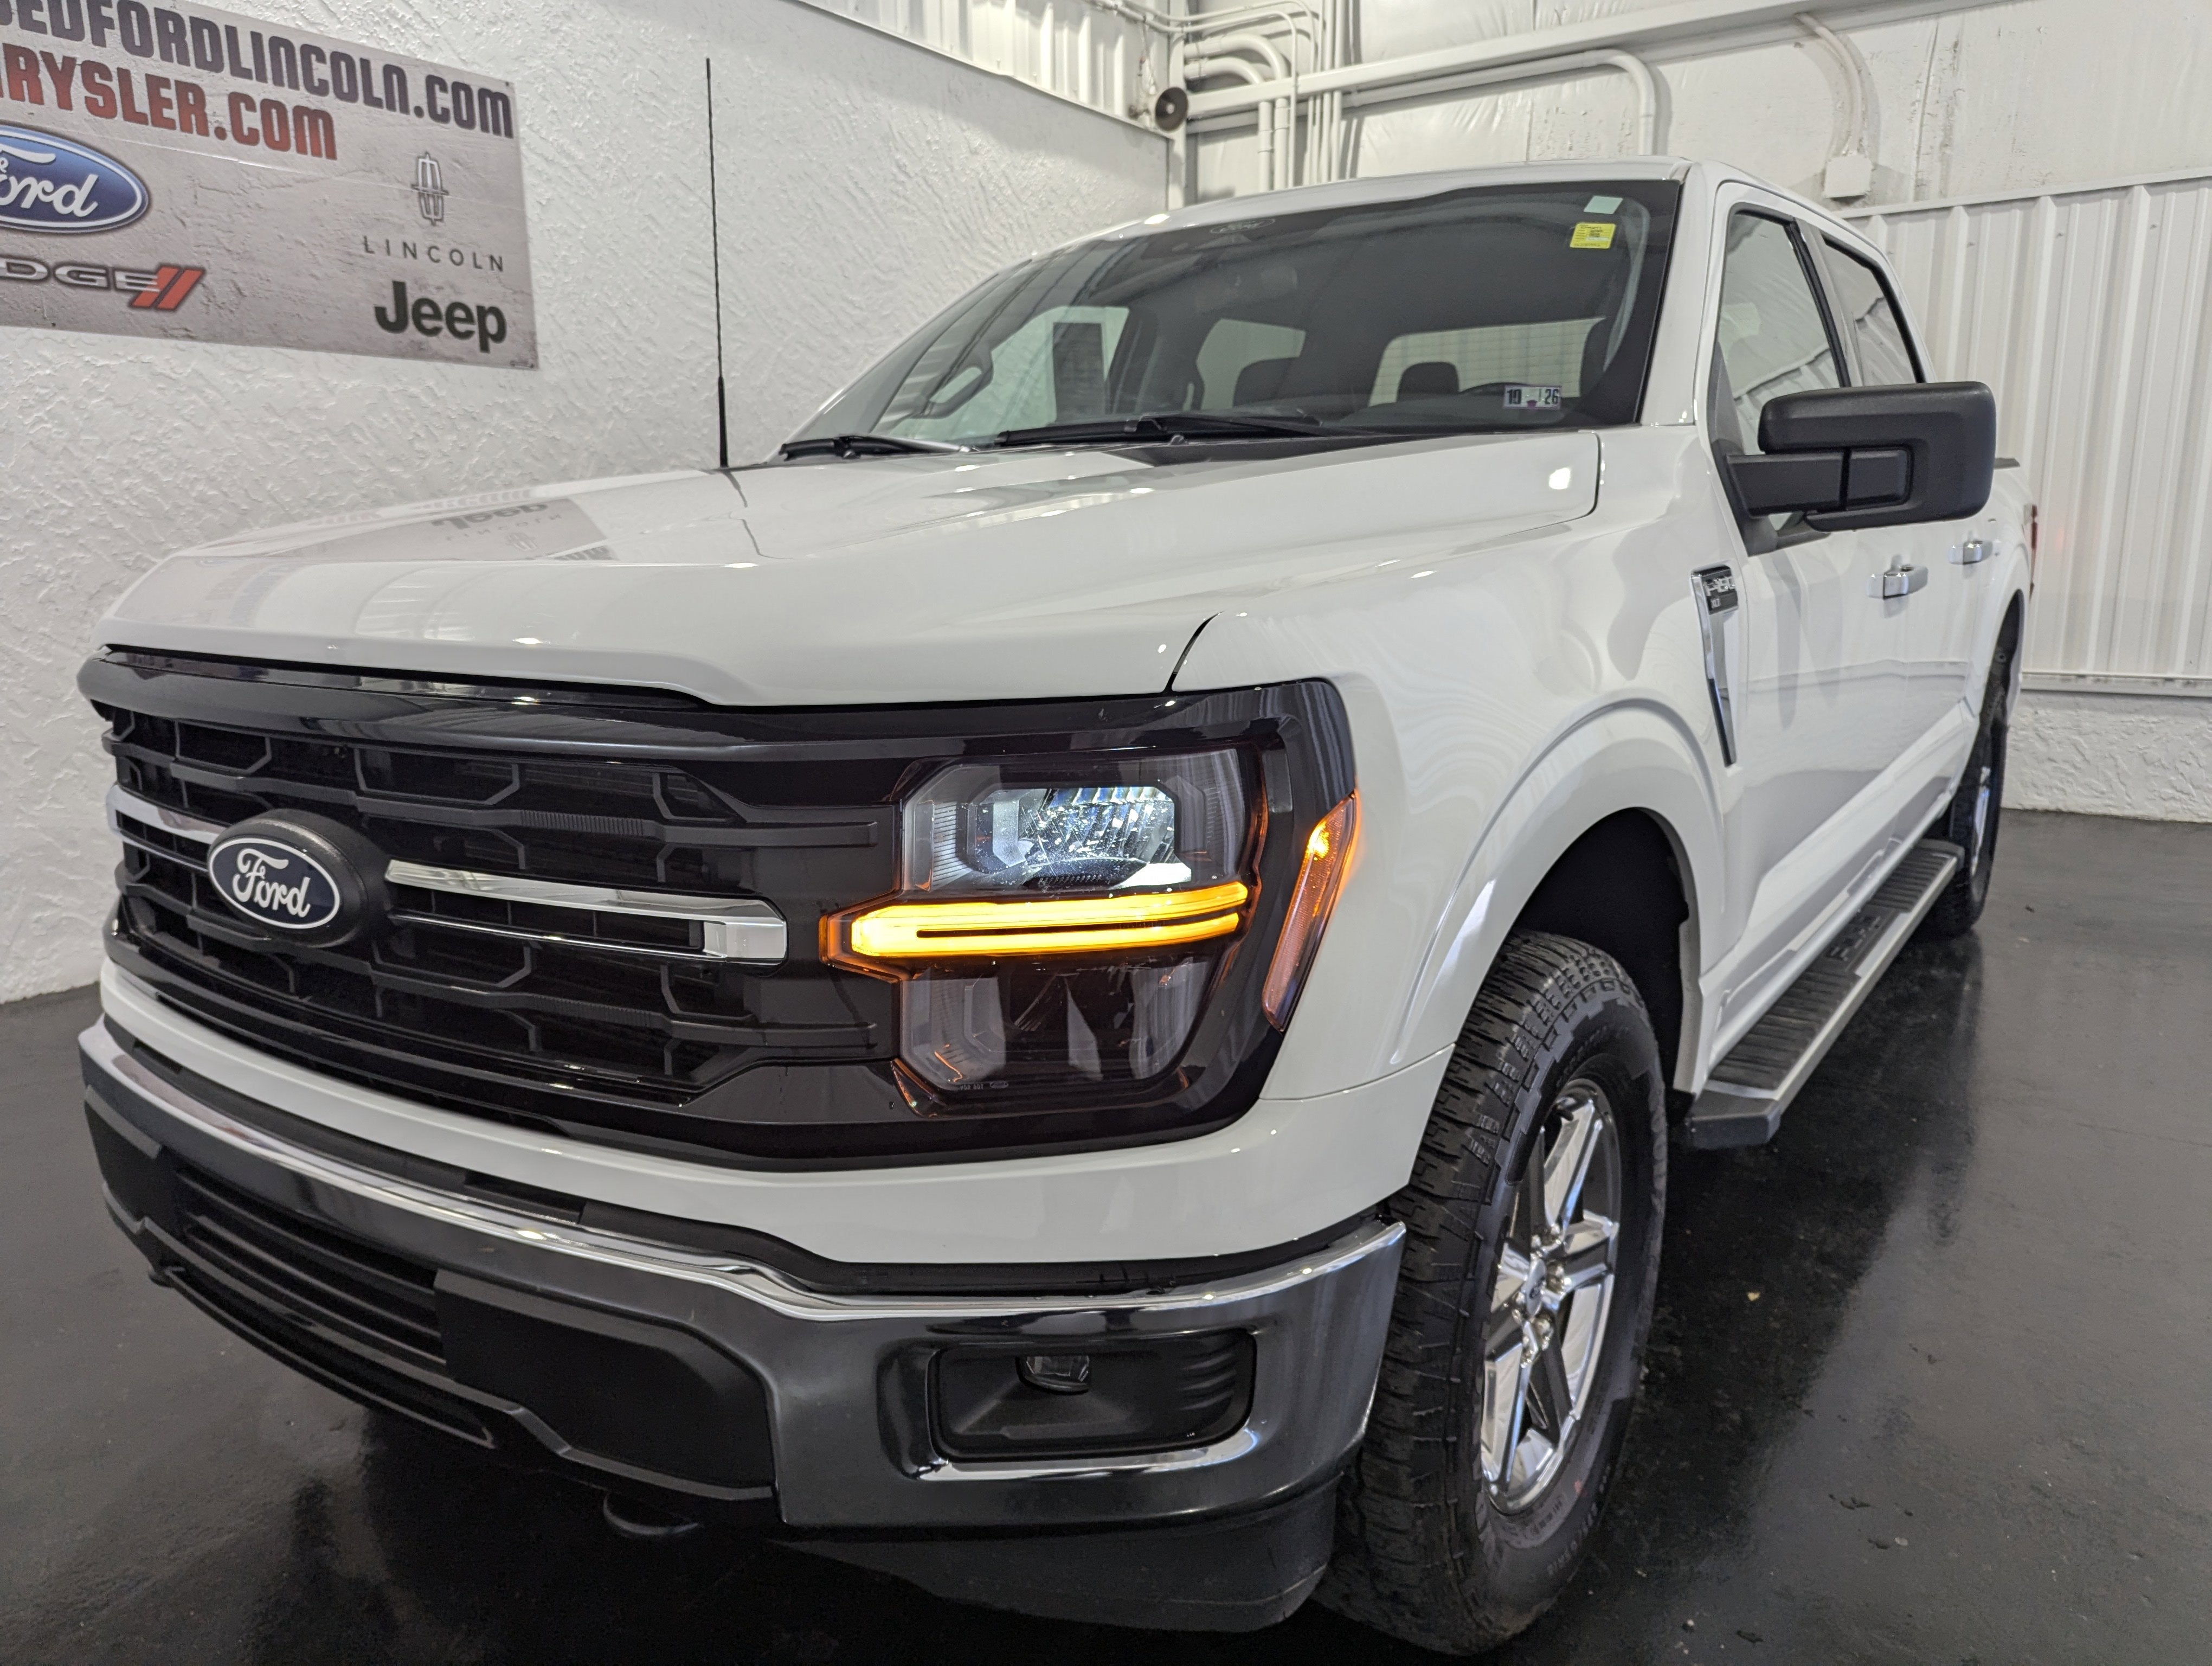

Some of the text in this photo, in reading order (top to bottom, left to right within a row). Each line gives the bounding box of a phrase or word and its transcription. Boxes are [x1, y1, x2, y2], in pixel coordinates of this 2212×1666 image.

[0, 43, 337, 161] RYSLER.COM
[363, 235, 503, 271] LINCOLN
[374, 280, 507, 353] Jeep
[233, 848, 311, 918] Ford
